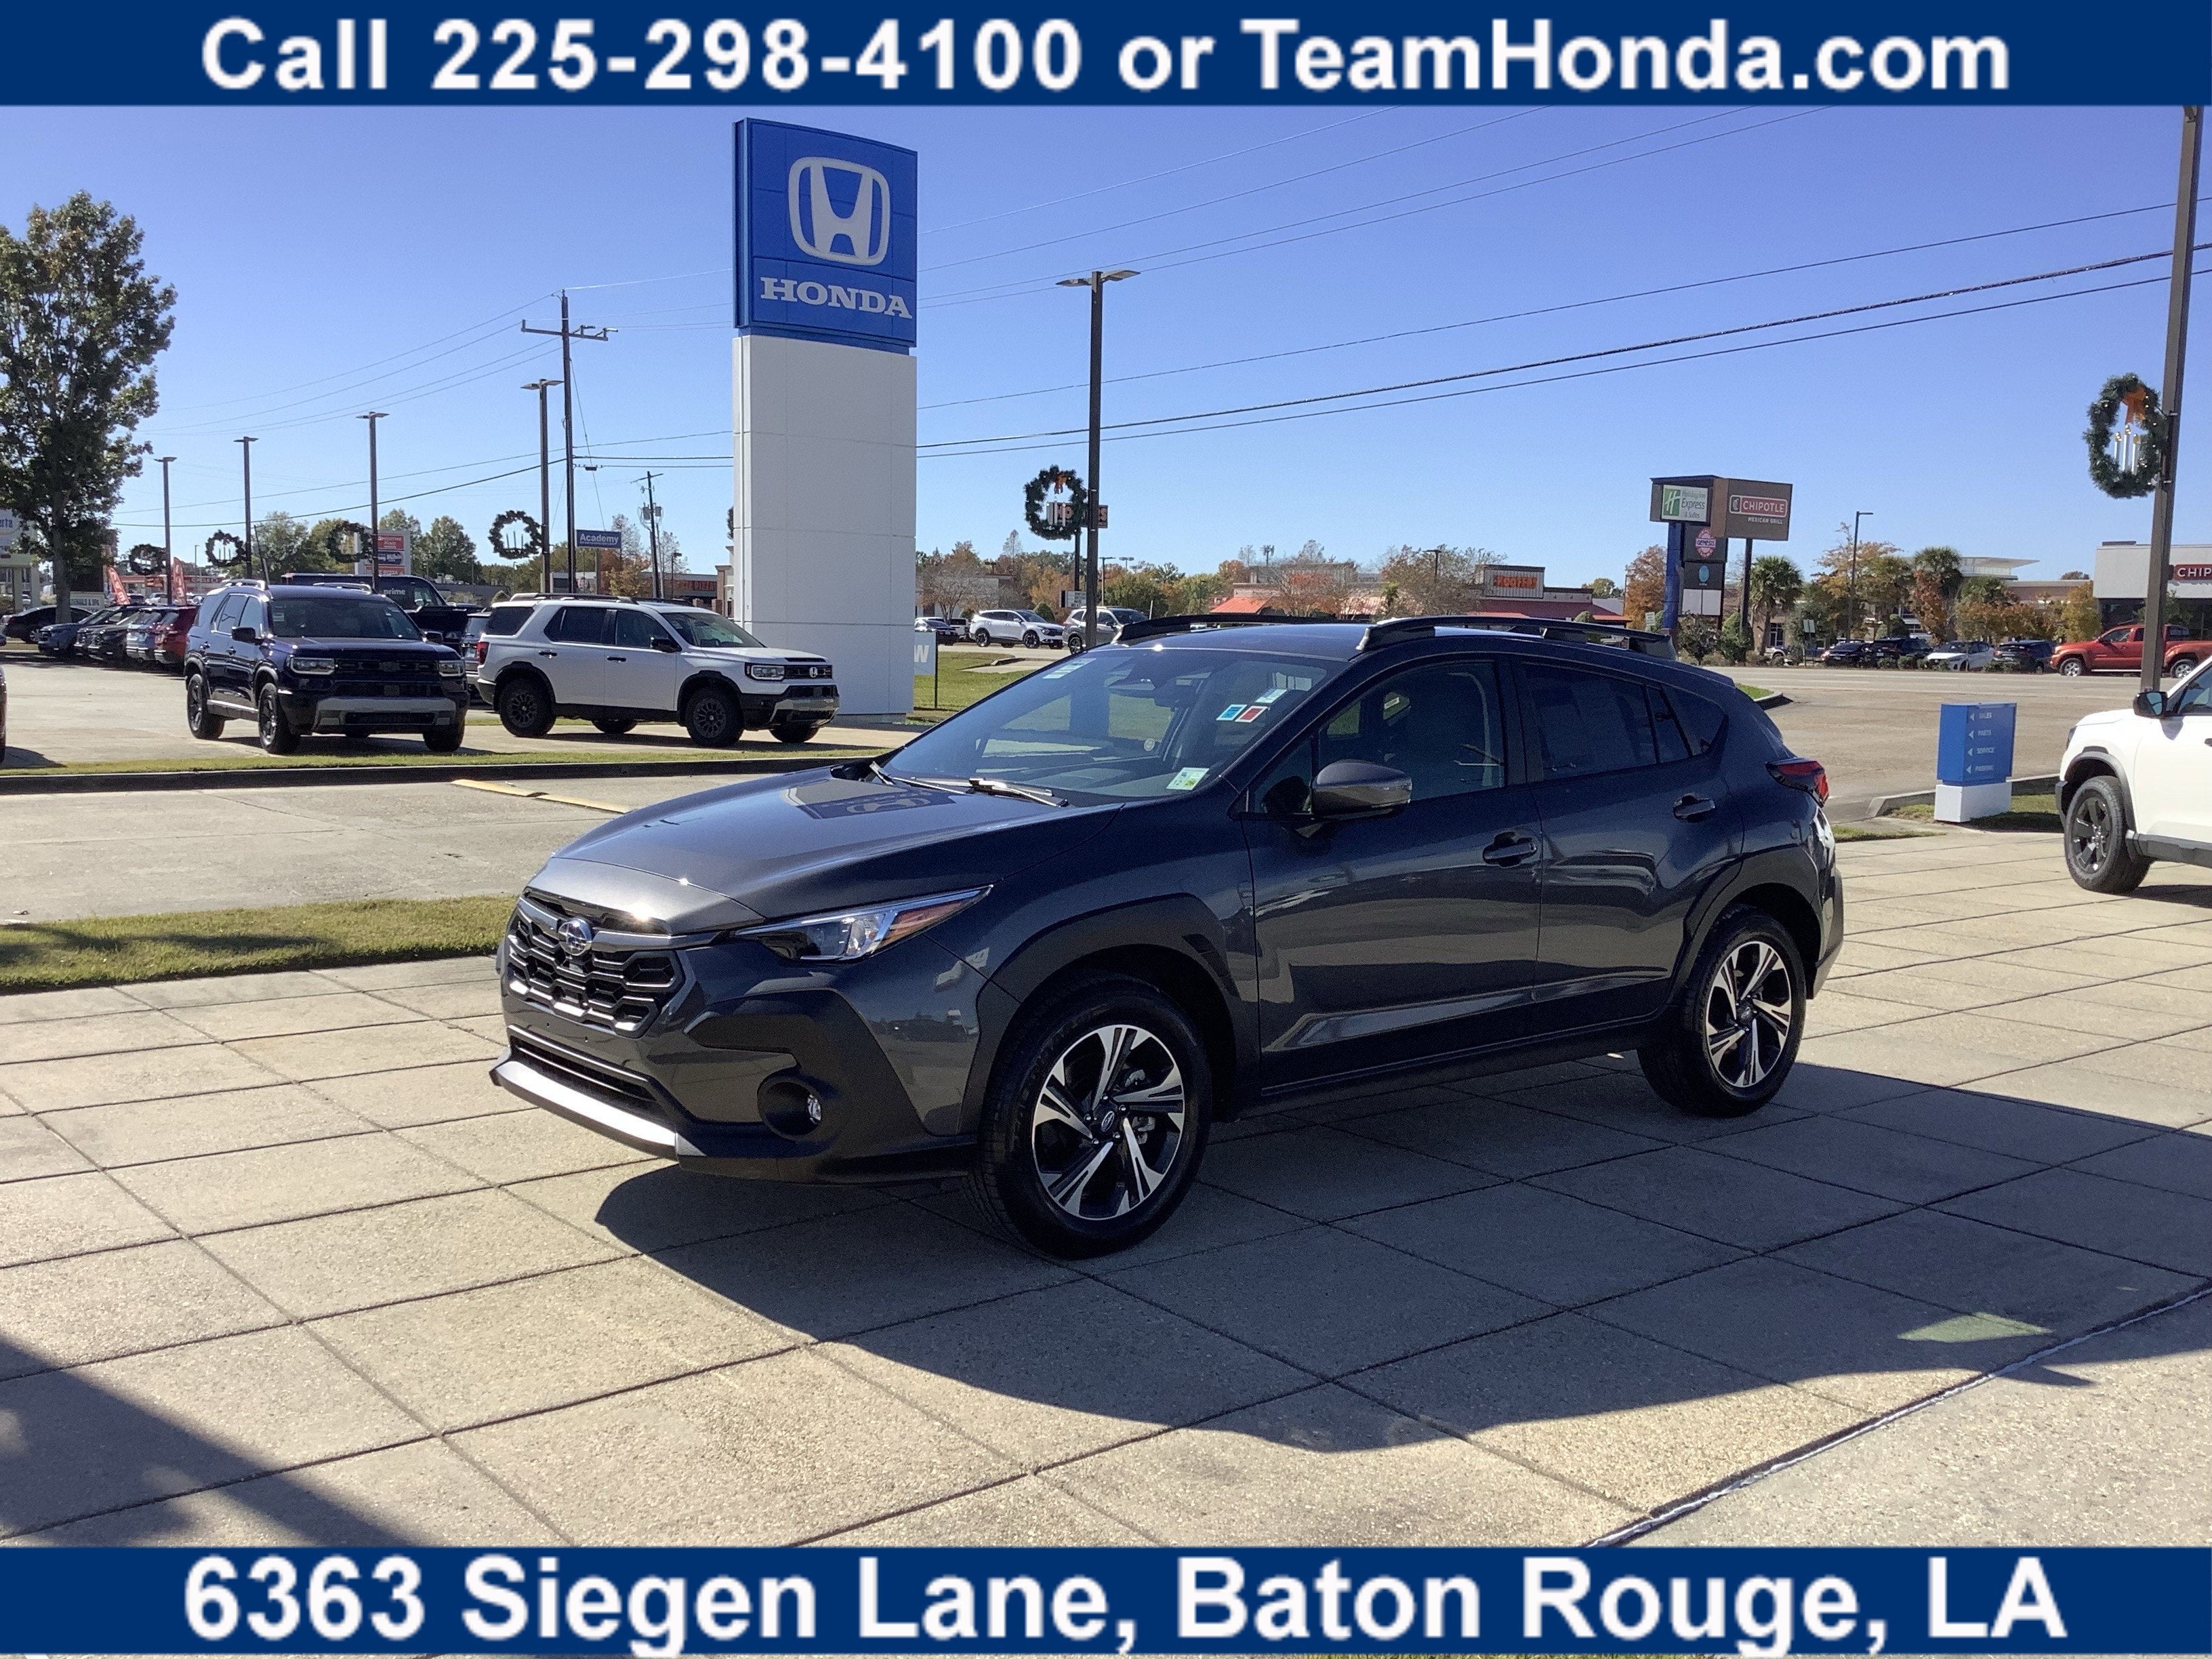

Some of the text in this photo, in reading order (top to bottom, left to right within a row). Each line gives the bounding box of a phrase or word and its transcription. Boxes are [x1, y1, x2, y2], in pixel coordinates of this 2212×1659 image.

[760, 276, 913, 319] HONDA
[1681, 498, 1706, 510] Express
[1742, 501, 1785, 513] CHIPOTLE
[579, 533, 619, 545] Academy
[2177, 567, 2212, 577] CHIP
[384, 588, 406, 596] prime
